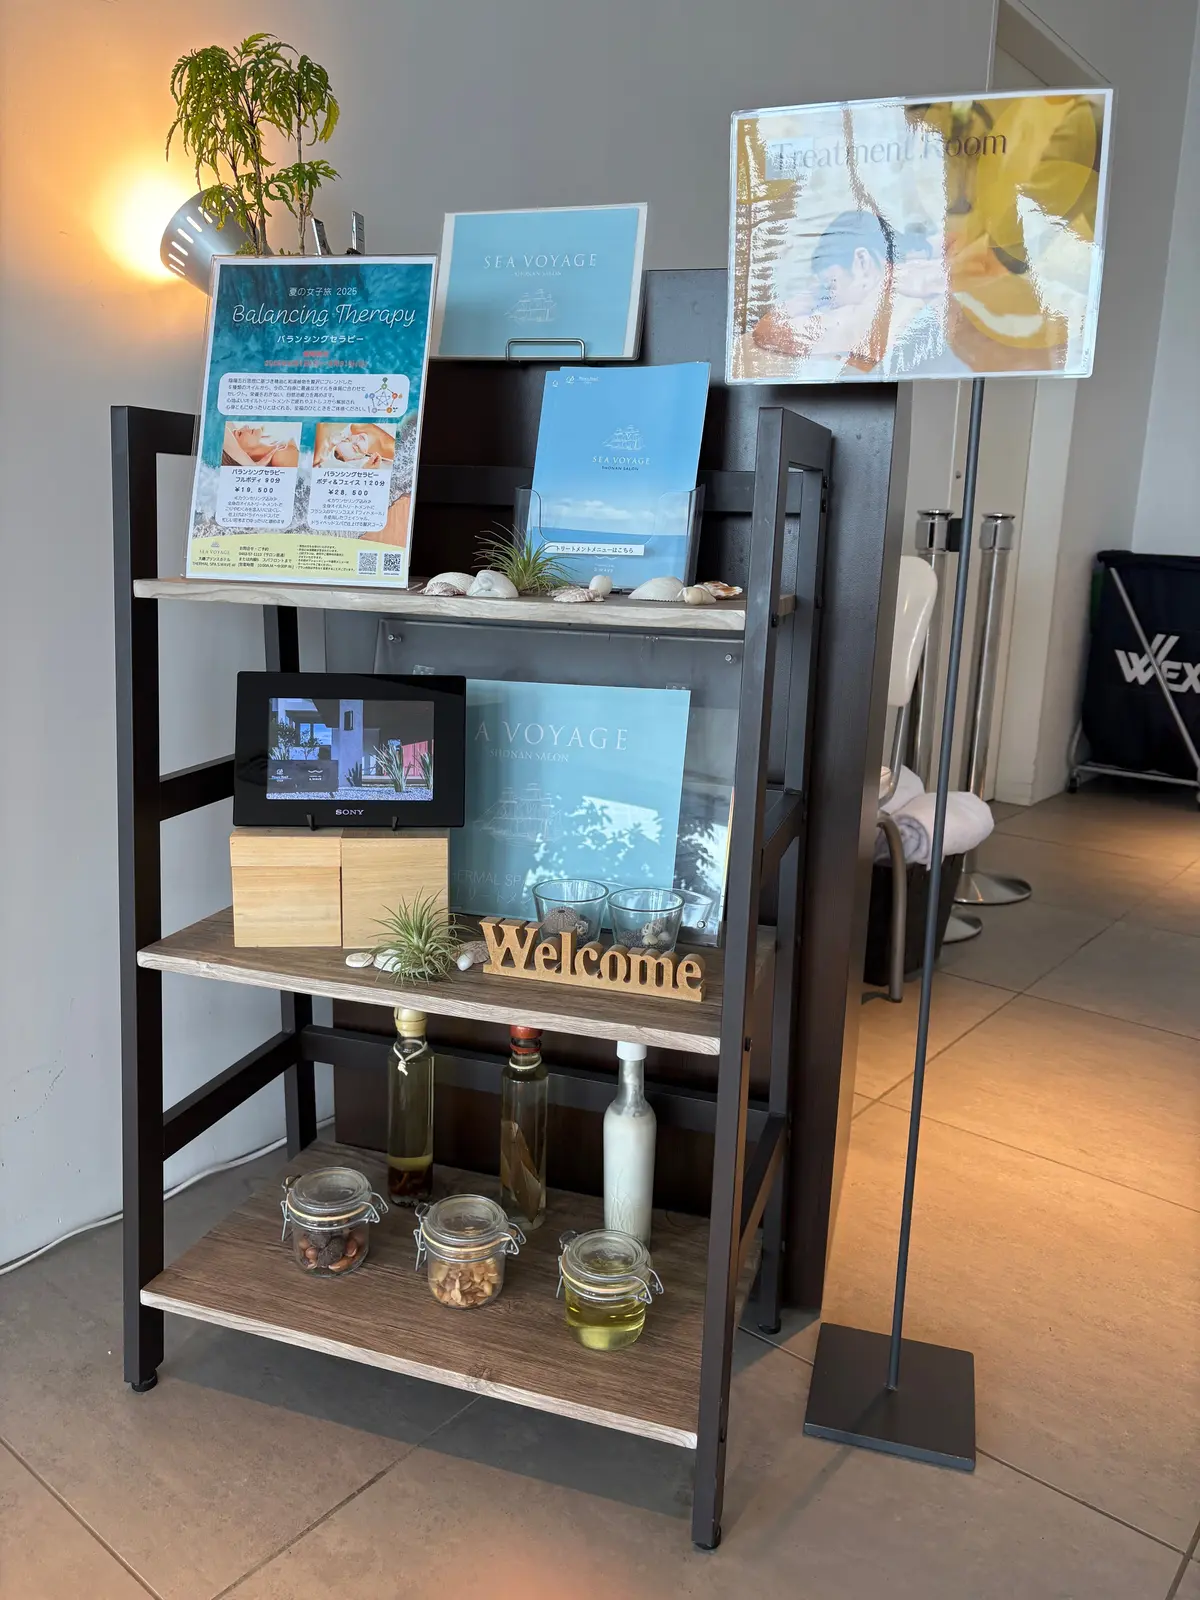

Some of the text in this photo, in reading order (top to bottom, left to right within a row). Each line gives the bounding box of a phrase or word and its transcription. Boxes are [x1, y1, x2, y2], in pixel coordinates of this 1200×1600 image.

[483, 253, 598, 269] SEA VOYAGE
[288, 287, 332, 297] 夏の女子旅
[232, 303, 416, 328] Balancing Therapy
[592, 456, 650, 465] SEA VOYAGE
[503, 721, 628, 750] VOYAGE
[479, 916, 706, 998] Welcome
